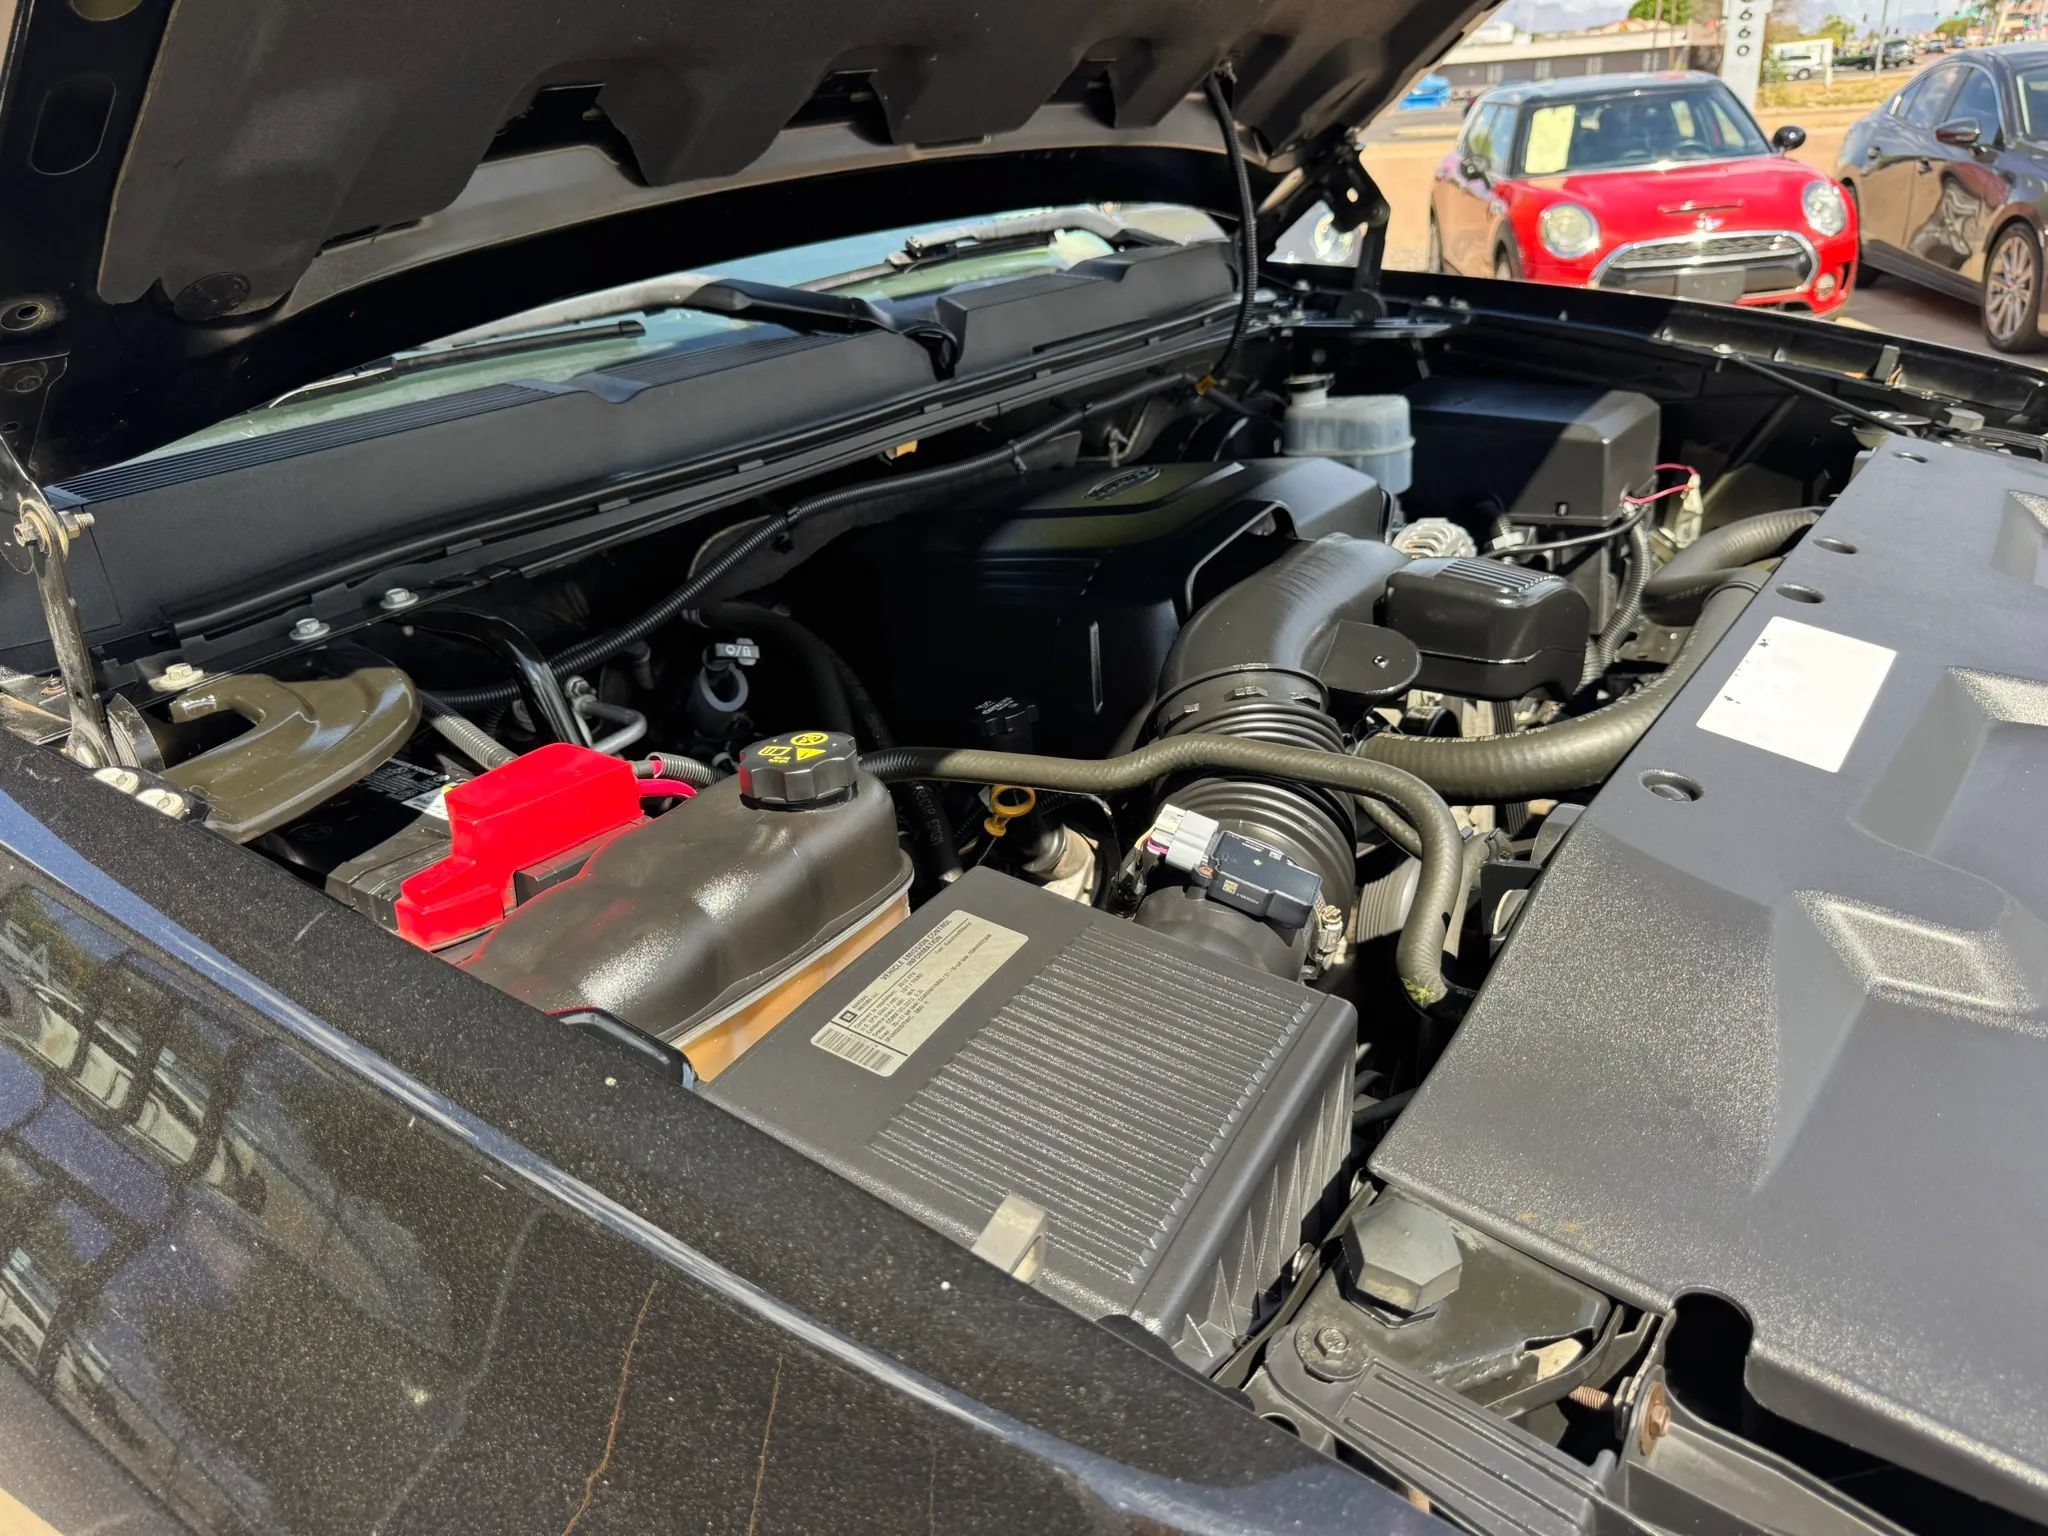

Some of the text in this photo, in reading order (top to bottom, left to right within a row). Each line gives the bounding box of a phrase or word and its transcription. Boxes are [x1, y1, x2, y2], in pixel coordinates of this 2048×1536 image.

[879, 959, 905, 980] VEHICLE
[926, 918, 952, 939] CONTROL
[905, 934, 943, 966] INFORMATION
